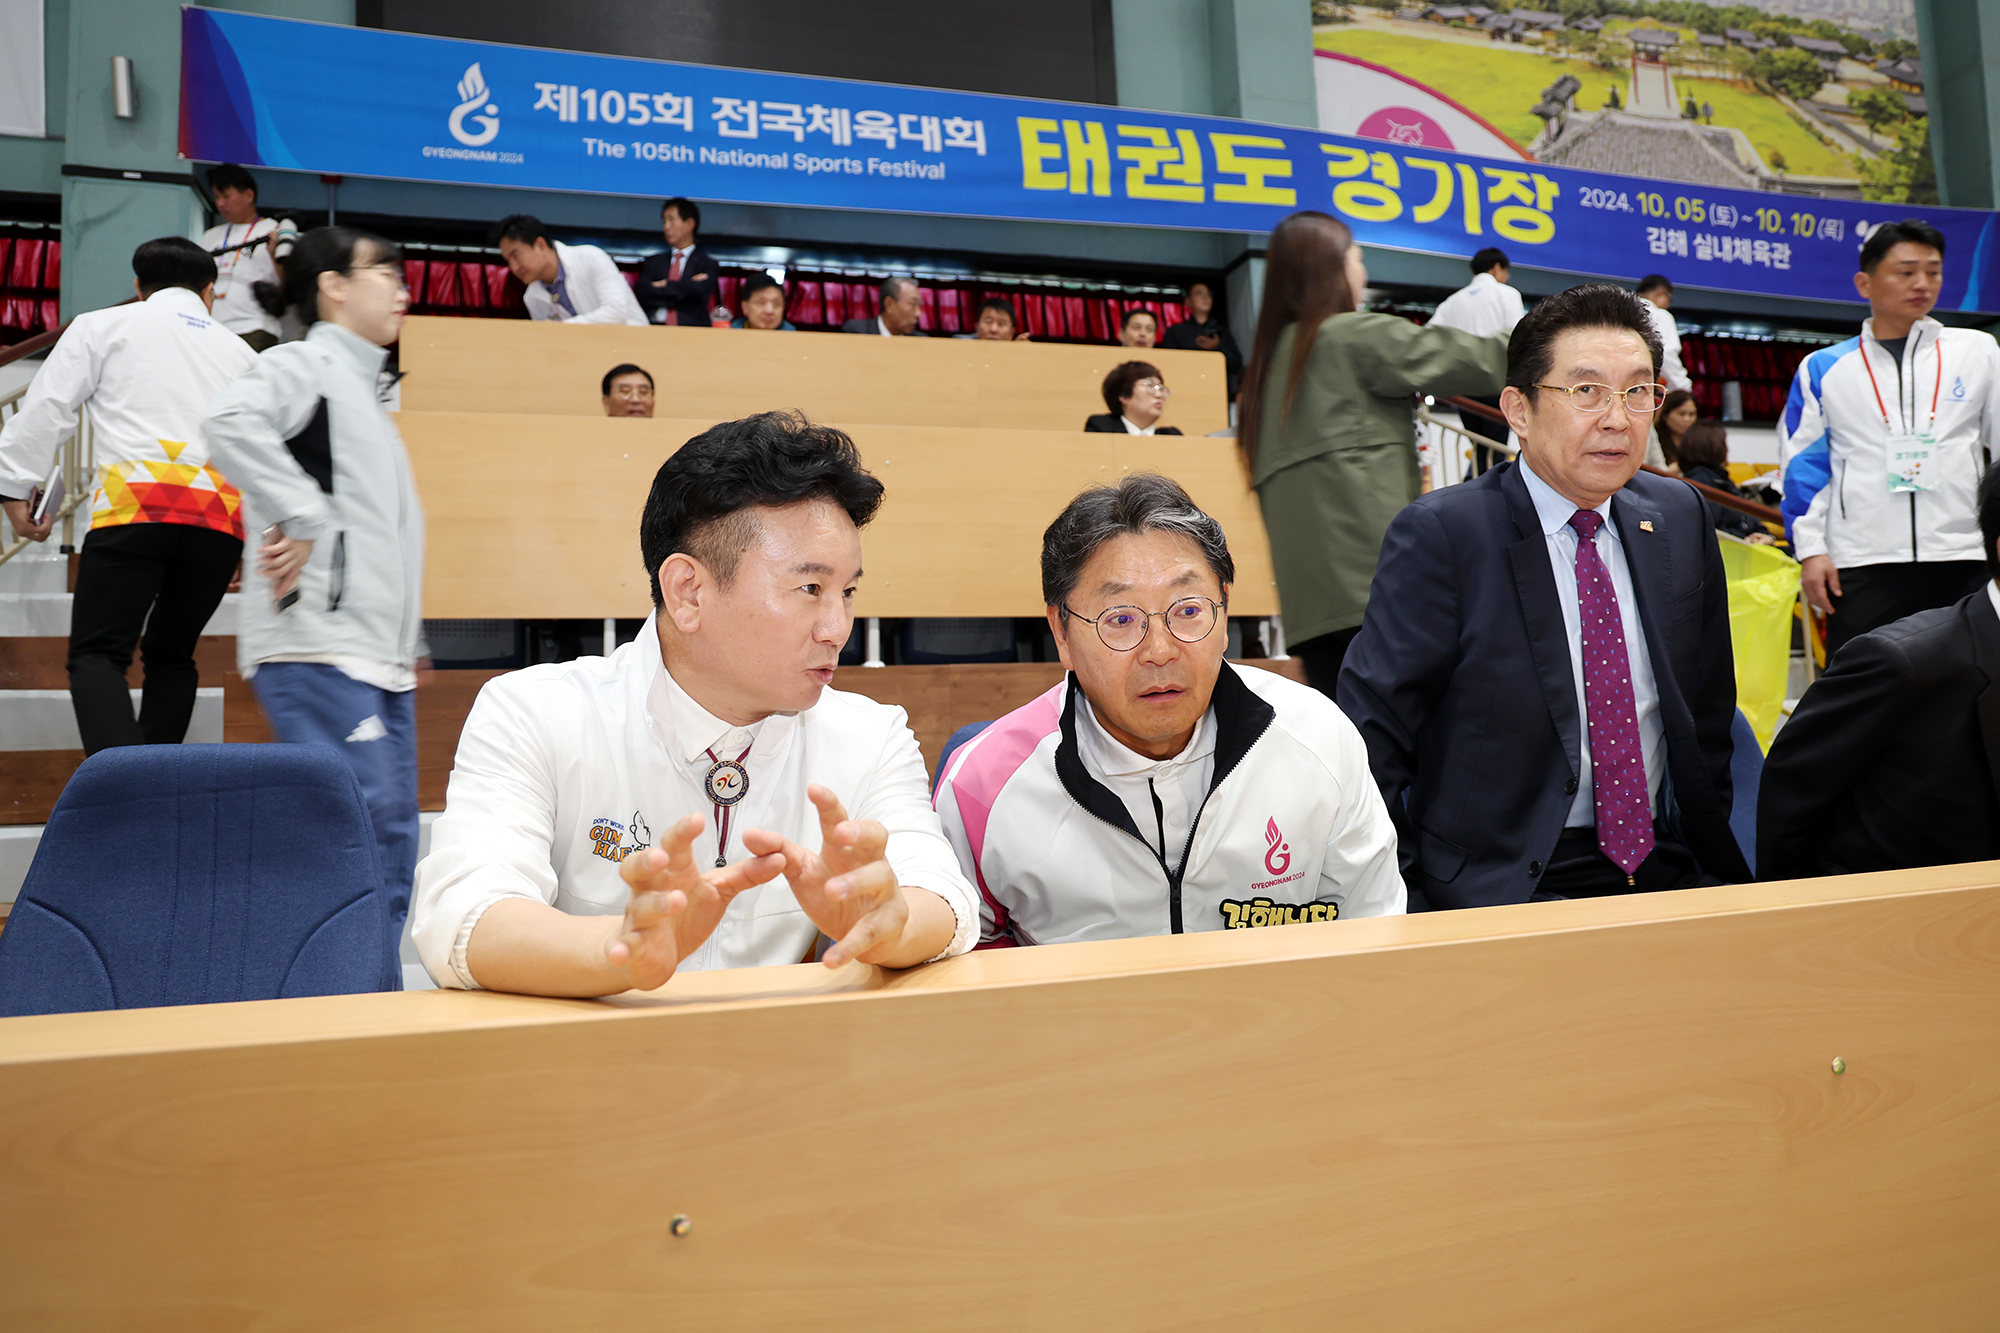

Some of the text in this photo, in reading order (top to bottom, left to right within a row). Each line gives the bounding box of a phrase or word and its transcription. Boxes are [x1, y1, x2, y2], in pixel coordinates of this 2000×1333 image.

[533, 81, 988, 156] 제105회 전국체육대회
[422, 146, 524, 164] GYEONGNAM 2024
[582, 137, 946, 181] The 105th National Sports Festival
[1016, 116, 1561, 245] 태권도 경기장
[1646, 226, 1792, 270] 김해 실내체육관
[590, 825, 623, 848] GIM
[1251, 871, 1306, 890] GYEONGNAM 2024
